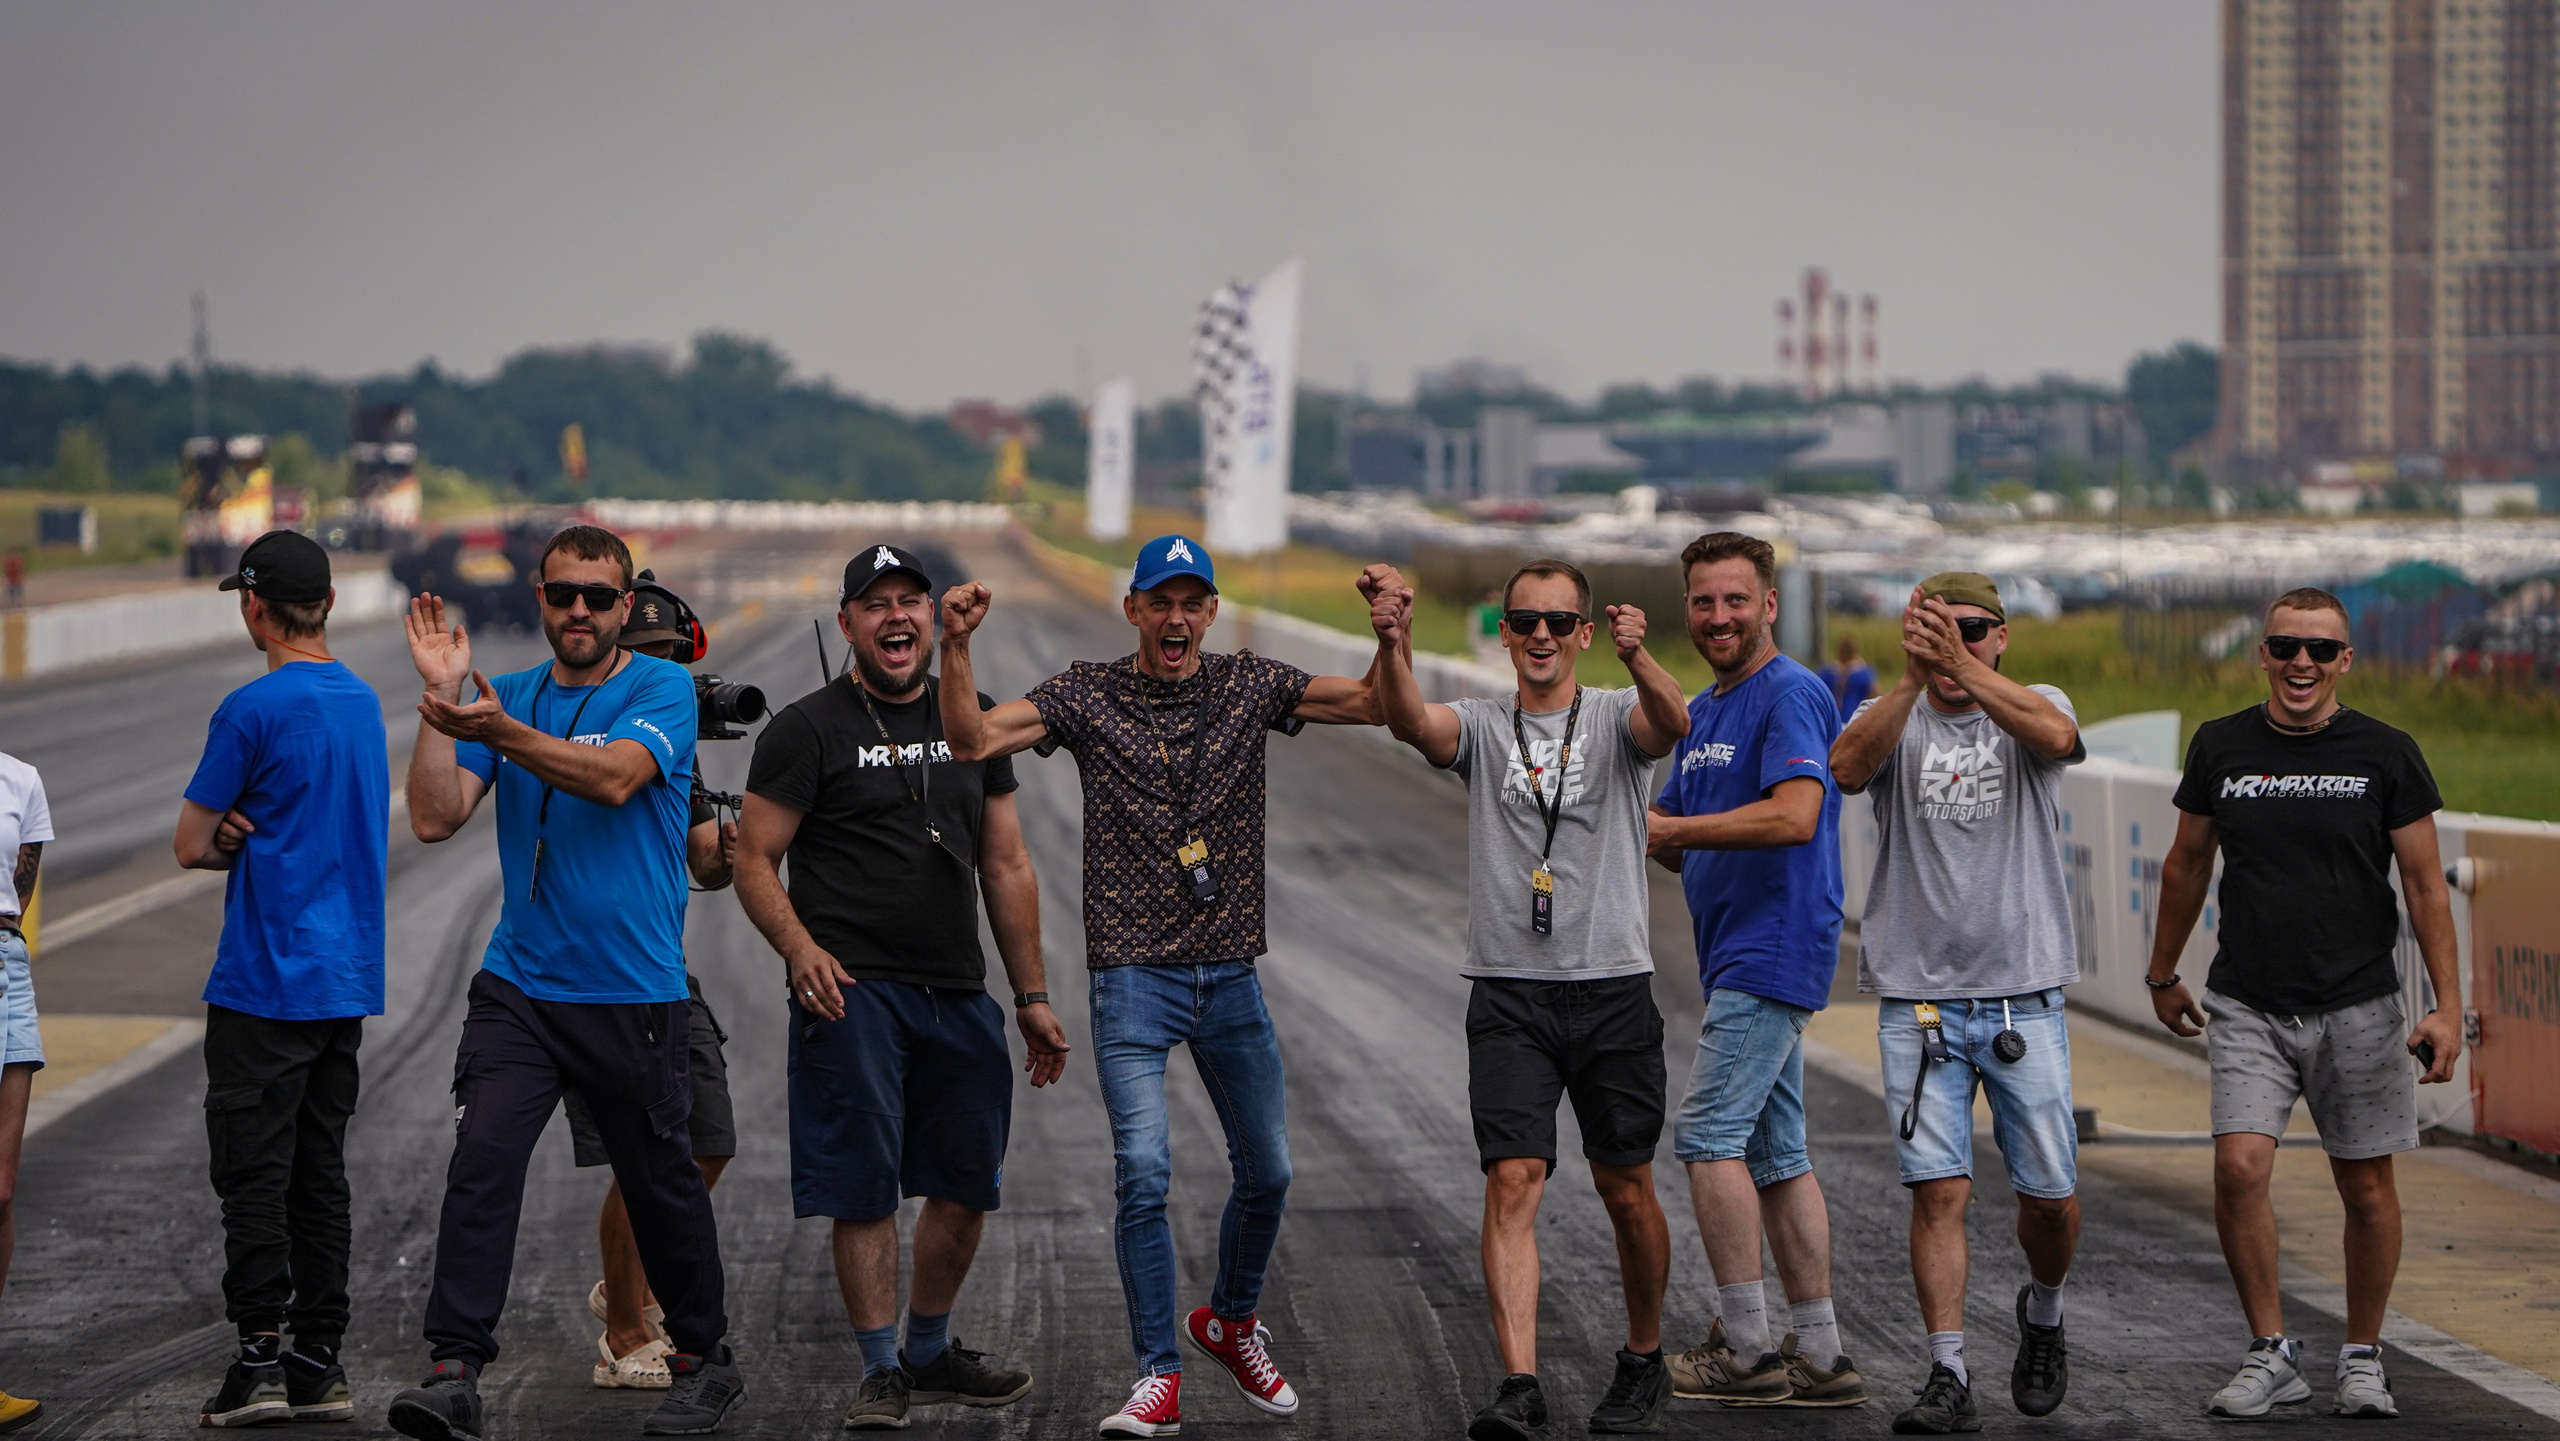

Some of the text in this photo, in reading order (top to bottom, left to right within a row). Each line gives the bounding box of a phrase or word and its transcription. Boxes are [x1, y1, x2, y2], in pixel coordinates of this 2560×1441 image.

[643, 722, 674, 756] SMP RACING
[1922, 736, 2003, 775] MAX
[1918, 767, 2003, 805] RIDE
[2265, 791, 2366, 799] MOTORSPORT
[1916, 799, 2002, 820] MOTORSPORT
